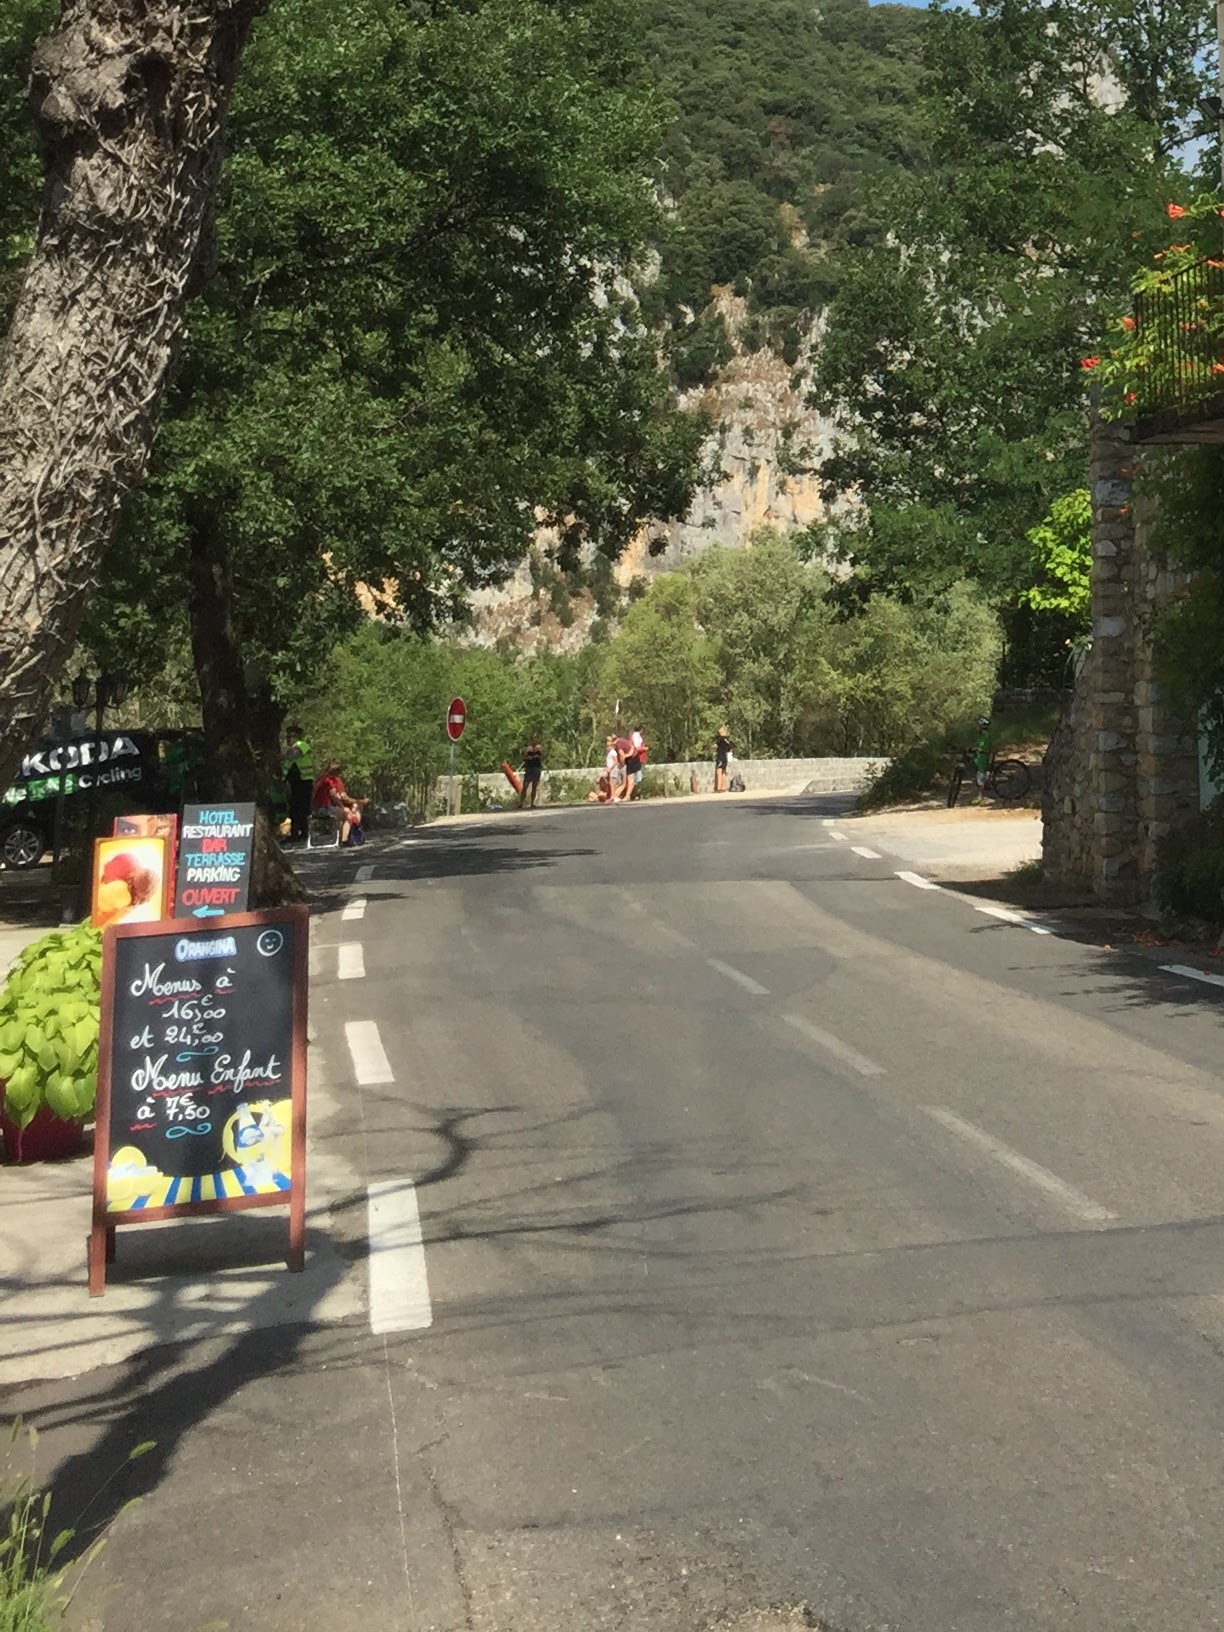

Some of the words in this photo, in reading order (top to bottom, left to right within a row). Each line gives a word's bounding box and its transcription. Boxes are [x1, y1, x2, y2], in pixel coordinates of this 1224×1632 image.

[14, 736, 140, 779] KODA
[199, 810, 239, 824] HOTEL
[182, 823, 254, 838] RESTAURANT
[202, 838, 228, 853] BAR
[185, 852, 246, 867] TERRASSE
[181, 888, 240, 905] OUVERT
[130, 962, 202, 996] Menus
[215, 968, 237, 988] à
[130, 1025, 154, 1049] et
[131, 1054, 204, 1091] Menu
[210, 1049, 281, 1093] Enfant
[137, 1096, 155, 1120] à
